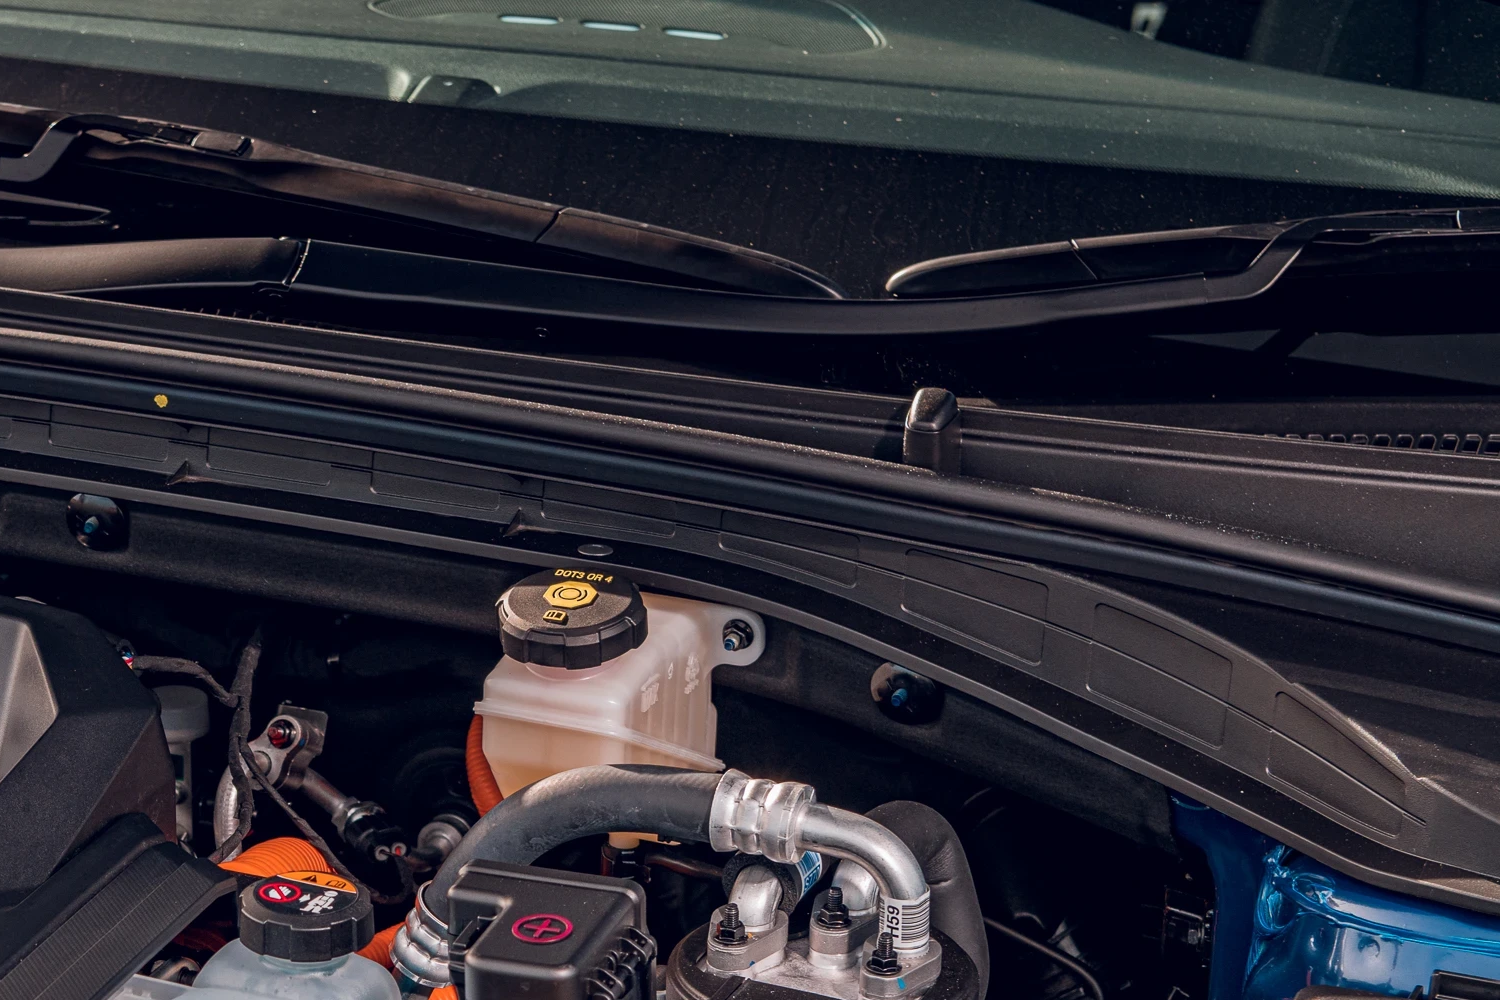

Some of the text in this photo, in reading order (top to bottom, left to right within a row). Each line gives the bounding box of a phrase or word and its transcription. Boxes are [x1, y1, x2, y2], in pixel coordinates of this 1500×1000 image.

[555, 569, 614, 583] DOT3 OR 4
